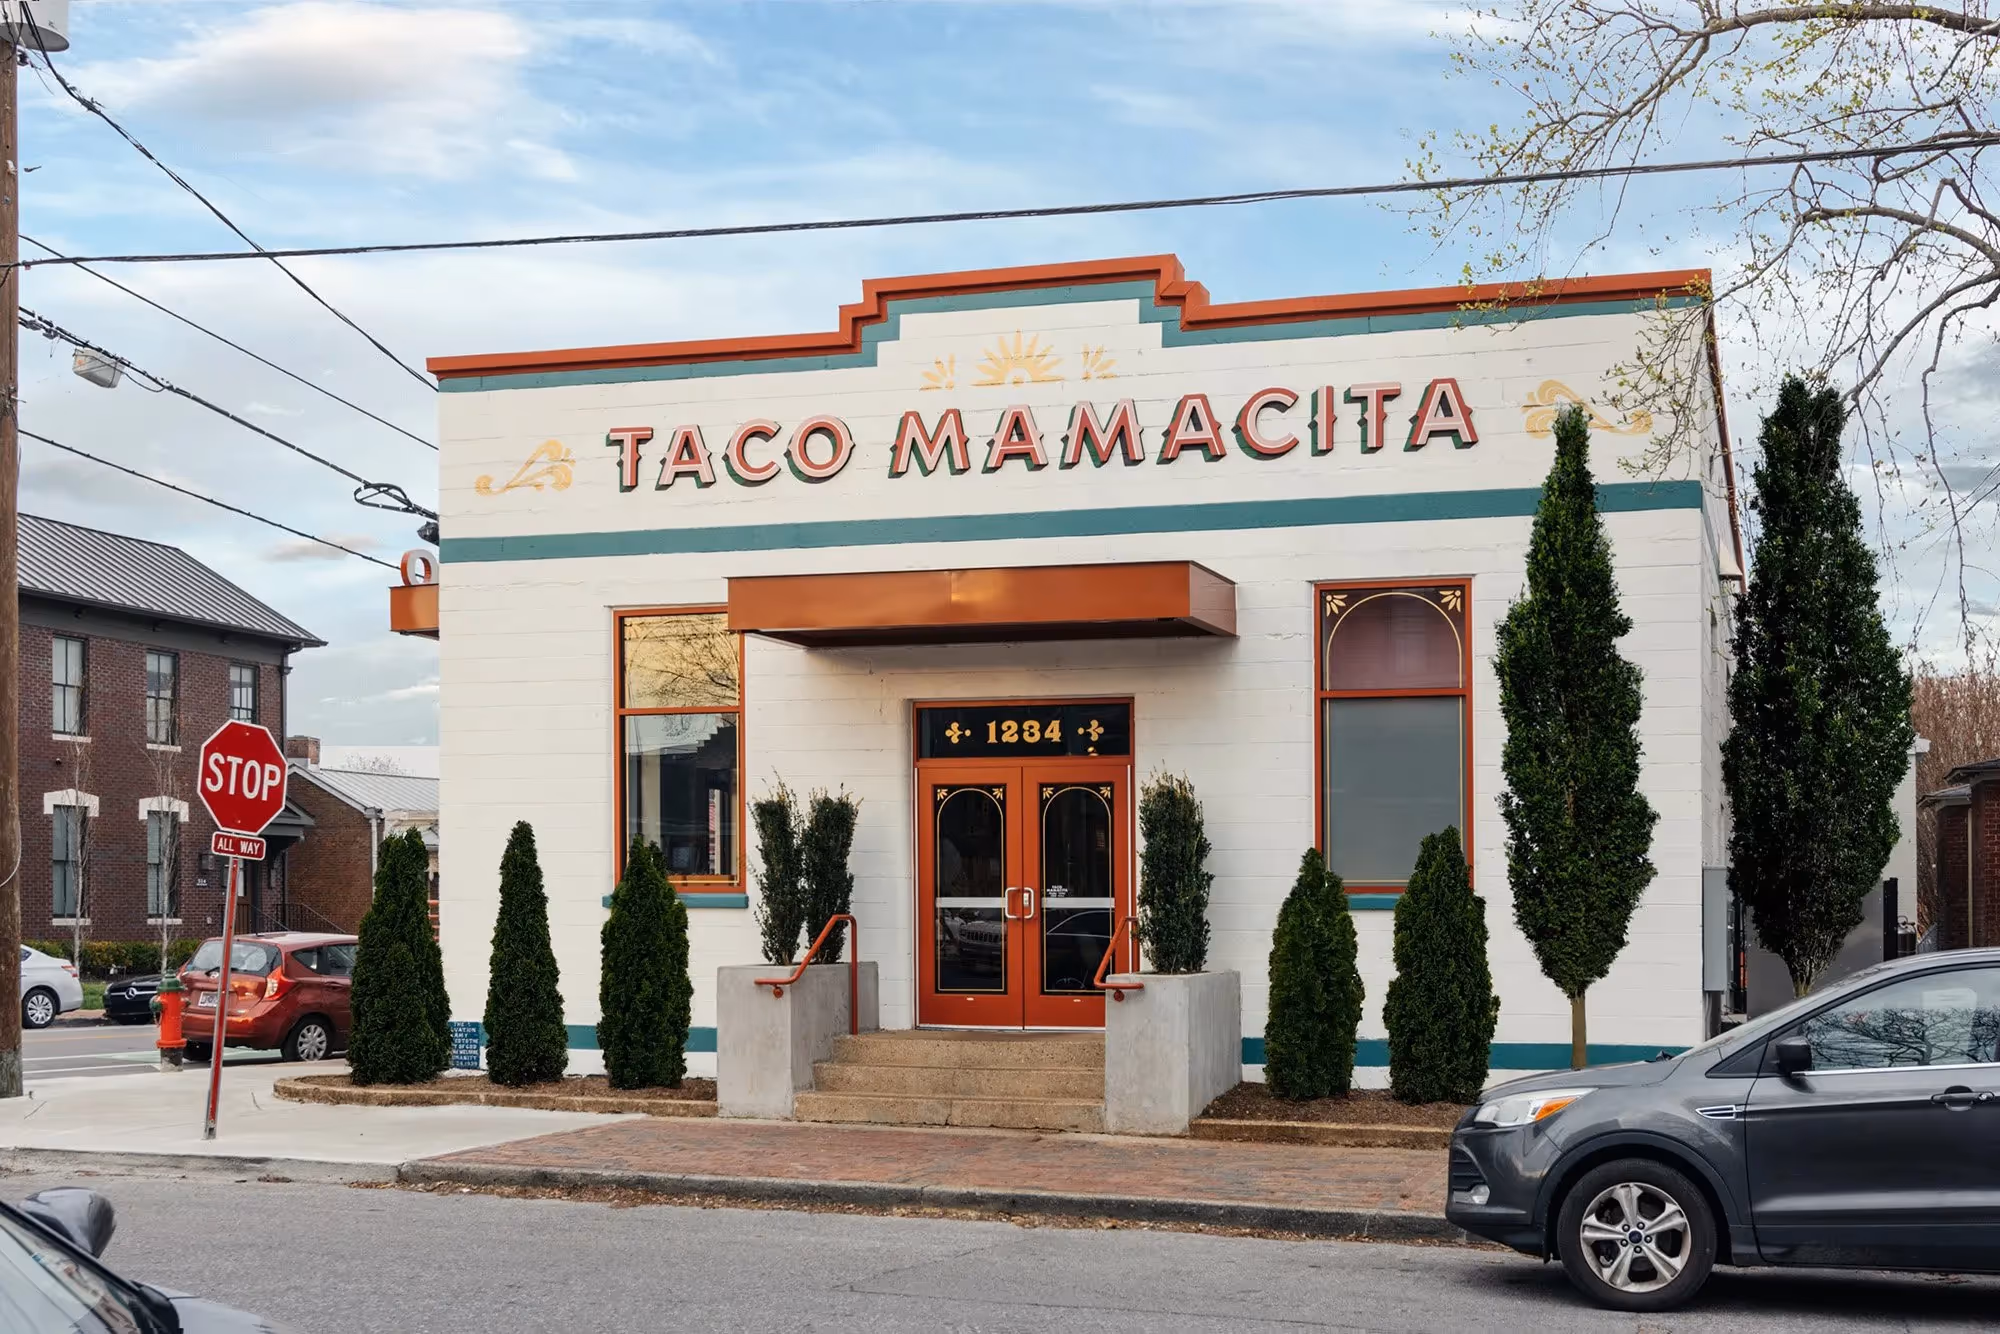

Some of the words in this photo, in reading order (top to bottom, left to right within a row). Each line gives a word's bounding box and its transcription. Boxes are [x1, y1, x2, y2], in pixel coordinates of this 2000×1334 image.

[606, 414, 855, 493] TACO
[888, 377, 1479, 479] MAMACITA
[986, 719, 1062, 744] 1234
[205, 752, 281, 801] STOP
[217, 837, 234, 852] ALL
[240, 840, 261, 855] WAY
